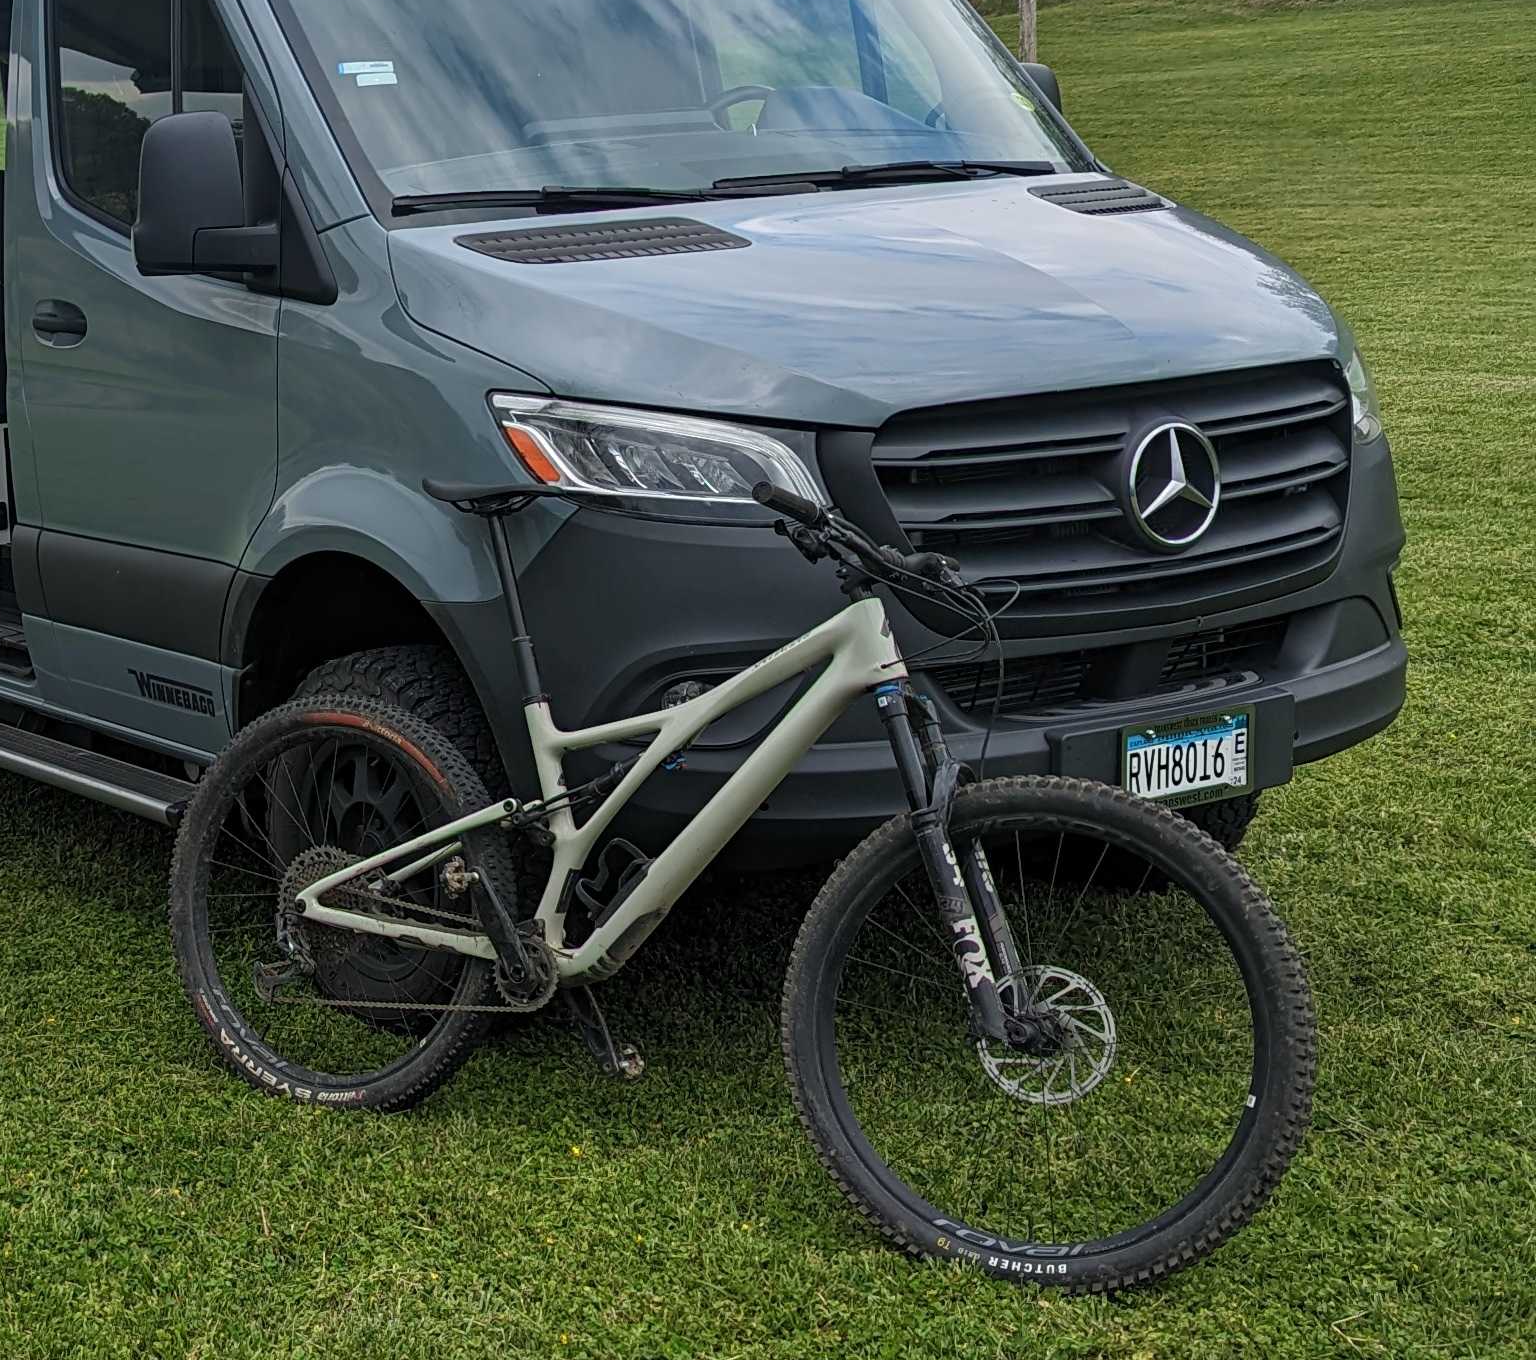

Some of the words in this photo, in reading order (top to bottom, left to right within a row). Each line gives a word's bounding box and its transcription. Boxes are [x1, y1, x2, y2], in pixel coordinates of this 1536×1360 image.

[128, 668, 216, 717] WINNEBAGO
[1129, 736, 1225, 794] RVH8016
[952, 915, 996, 989] FOX
[220, 1027, 312, 1099] SYERRA
[988, 1256, 1067, 1275] BUTCHER
